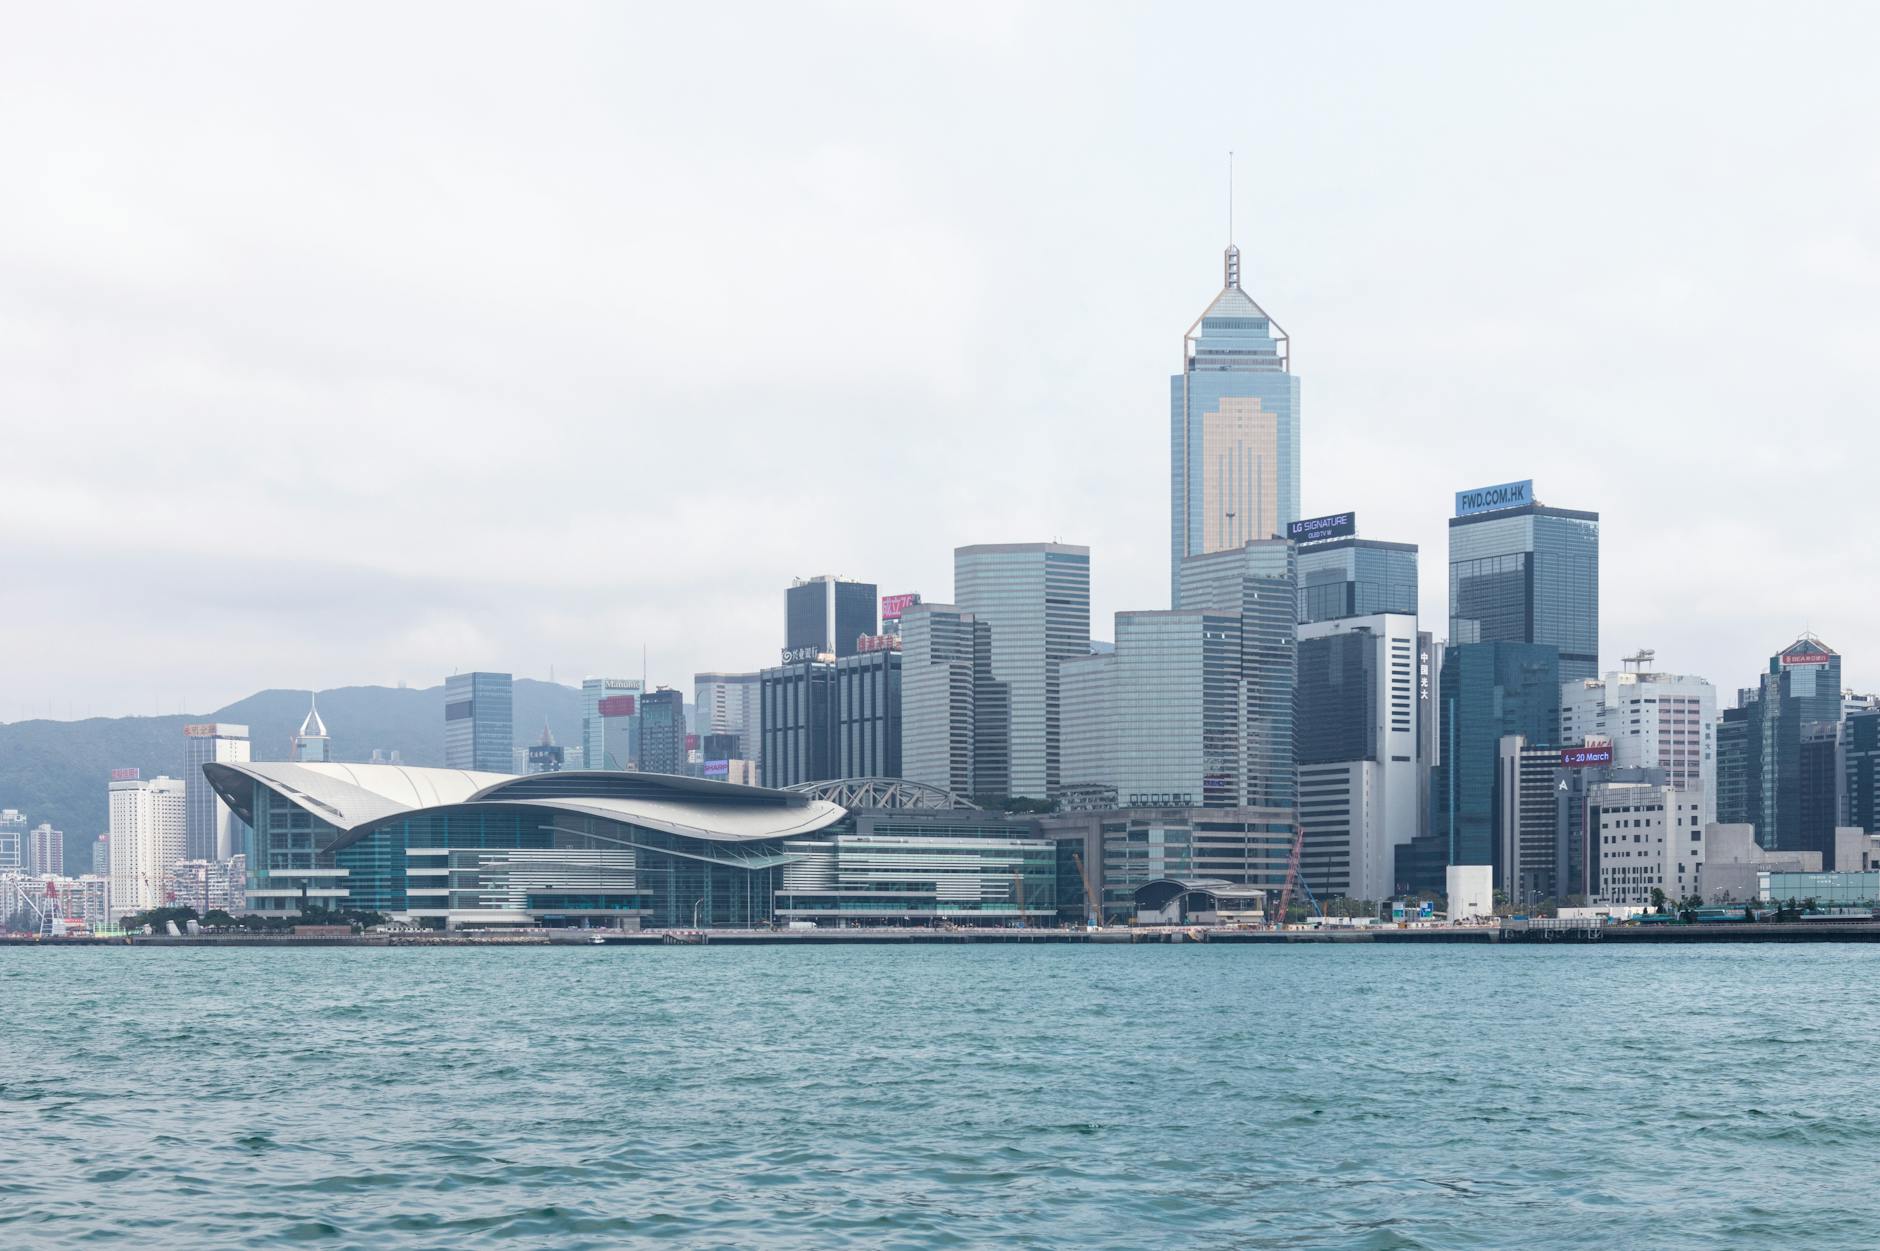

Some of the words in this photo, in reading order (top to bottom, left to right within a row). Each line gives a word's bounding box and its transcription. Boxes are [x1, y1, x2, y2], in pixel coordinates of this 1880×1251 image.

[1462, 485, 1524, 510] FWD.COM.HK
[1292, 522, 1303, 533] LG
[1304, 515, 1348, 531] SIGNATURE
[1564, 754, 1570, 763] 6
[1576, 753, 1585, 762] 20
[1586, 751, 1609, 761] March
